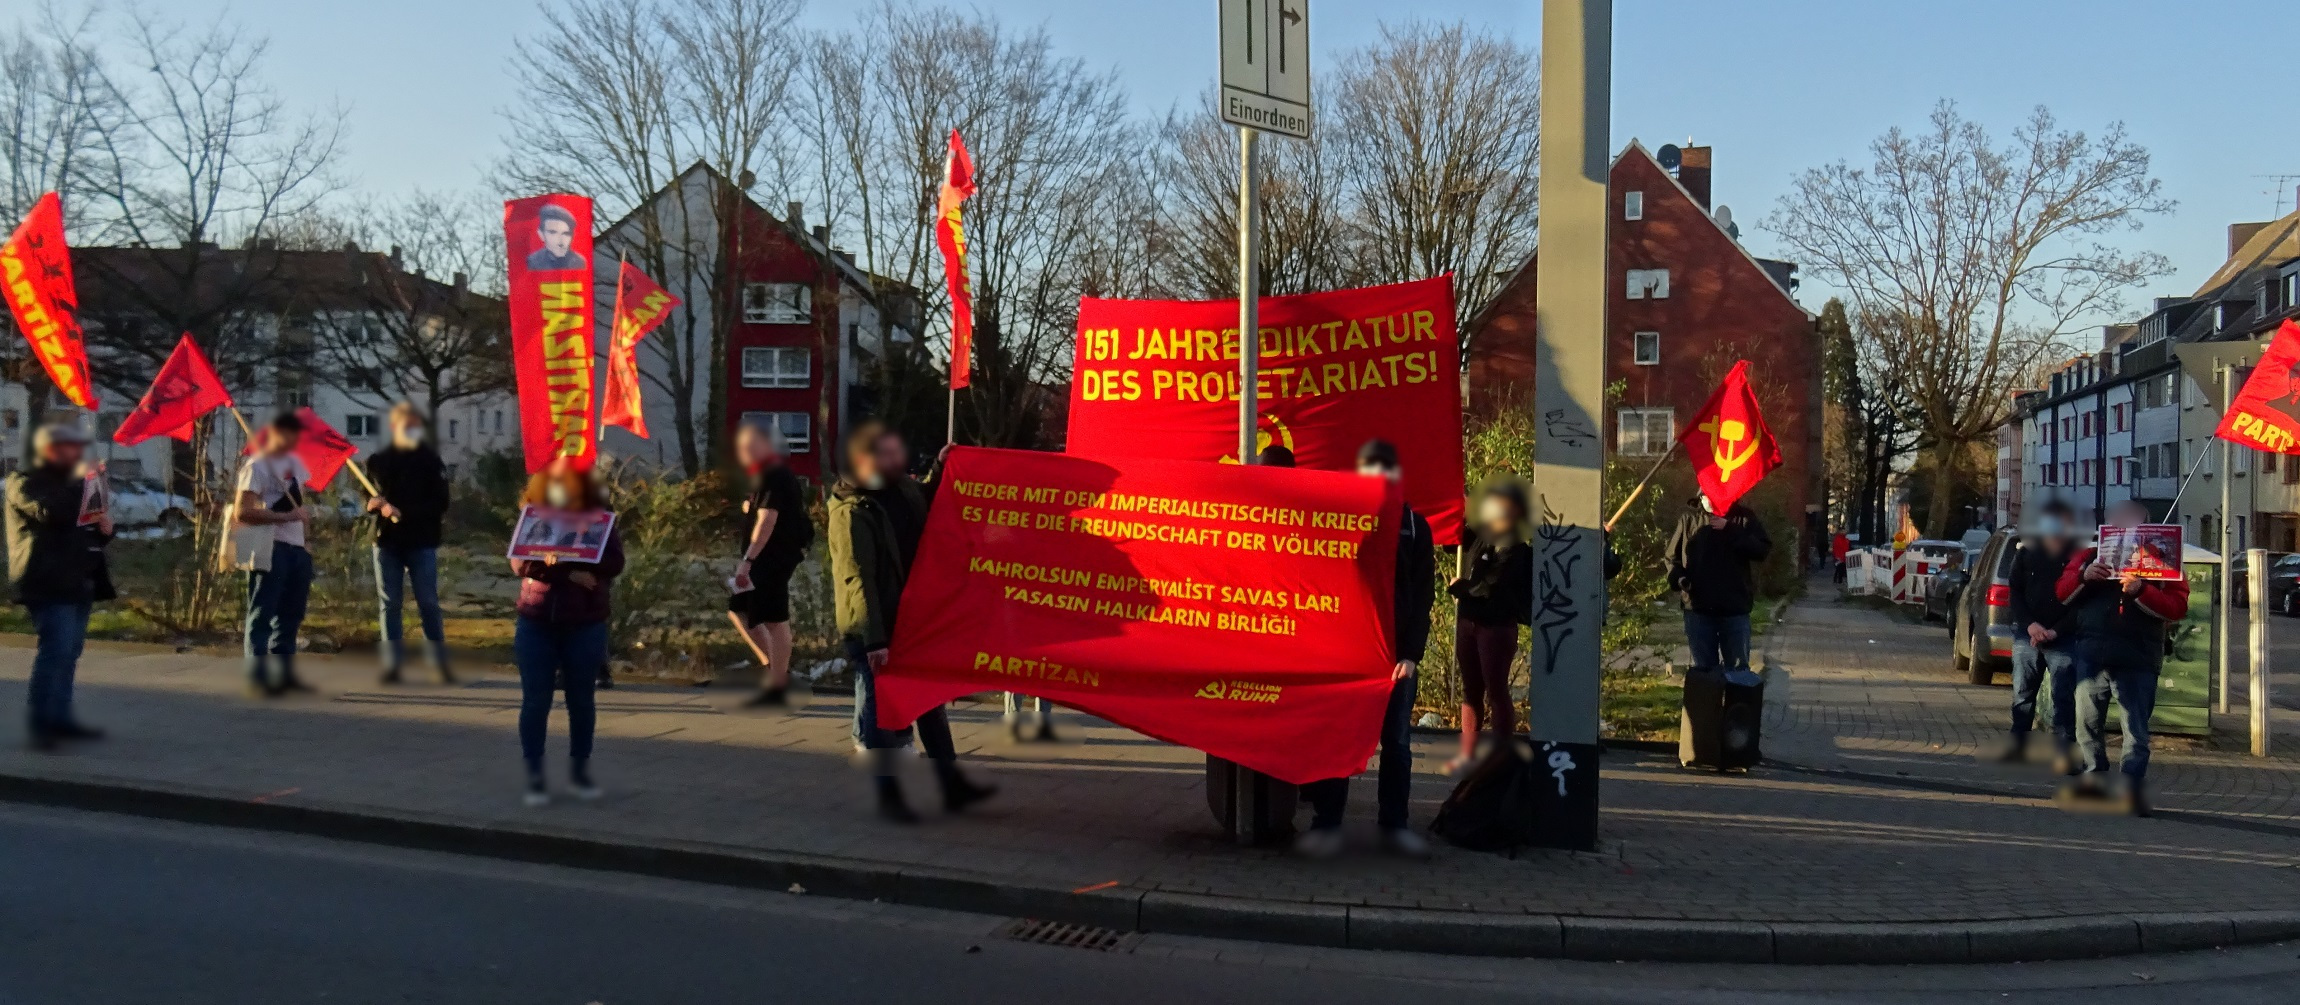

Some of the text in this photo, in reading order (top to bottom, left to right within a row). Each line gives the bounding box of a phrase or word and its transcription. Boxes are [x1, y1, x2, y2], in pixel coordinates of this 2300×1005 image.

[1230, 97, 1305, 133] Einordnen
[1084, 310, 1437, 361] 151 JAHRE DIKTATUR
[1083, 351, 1438, 402] DES PROLETARIATS!
[953, 479, 1379, 532] NIEDER MIT DEM IMPERIALISTISCHEN KRIEG!
[962, 505, 1358, 559] ES LEBE DIE FREUNDSCHAFT DER VÖLKER!
[969, 556, 1340, 613] KAHROLSUN EMPERYALİST SAVAŞ LAR!
[1004, 585, 1296, 636] YASASIN HALKLARIN BİRLİĞİ!
[974, 651, 1099, 687] PARTİZAN
[1231, 680, 1282, 693] REBELLION
[1228, 689, 1280, 704] RUHR
